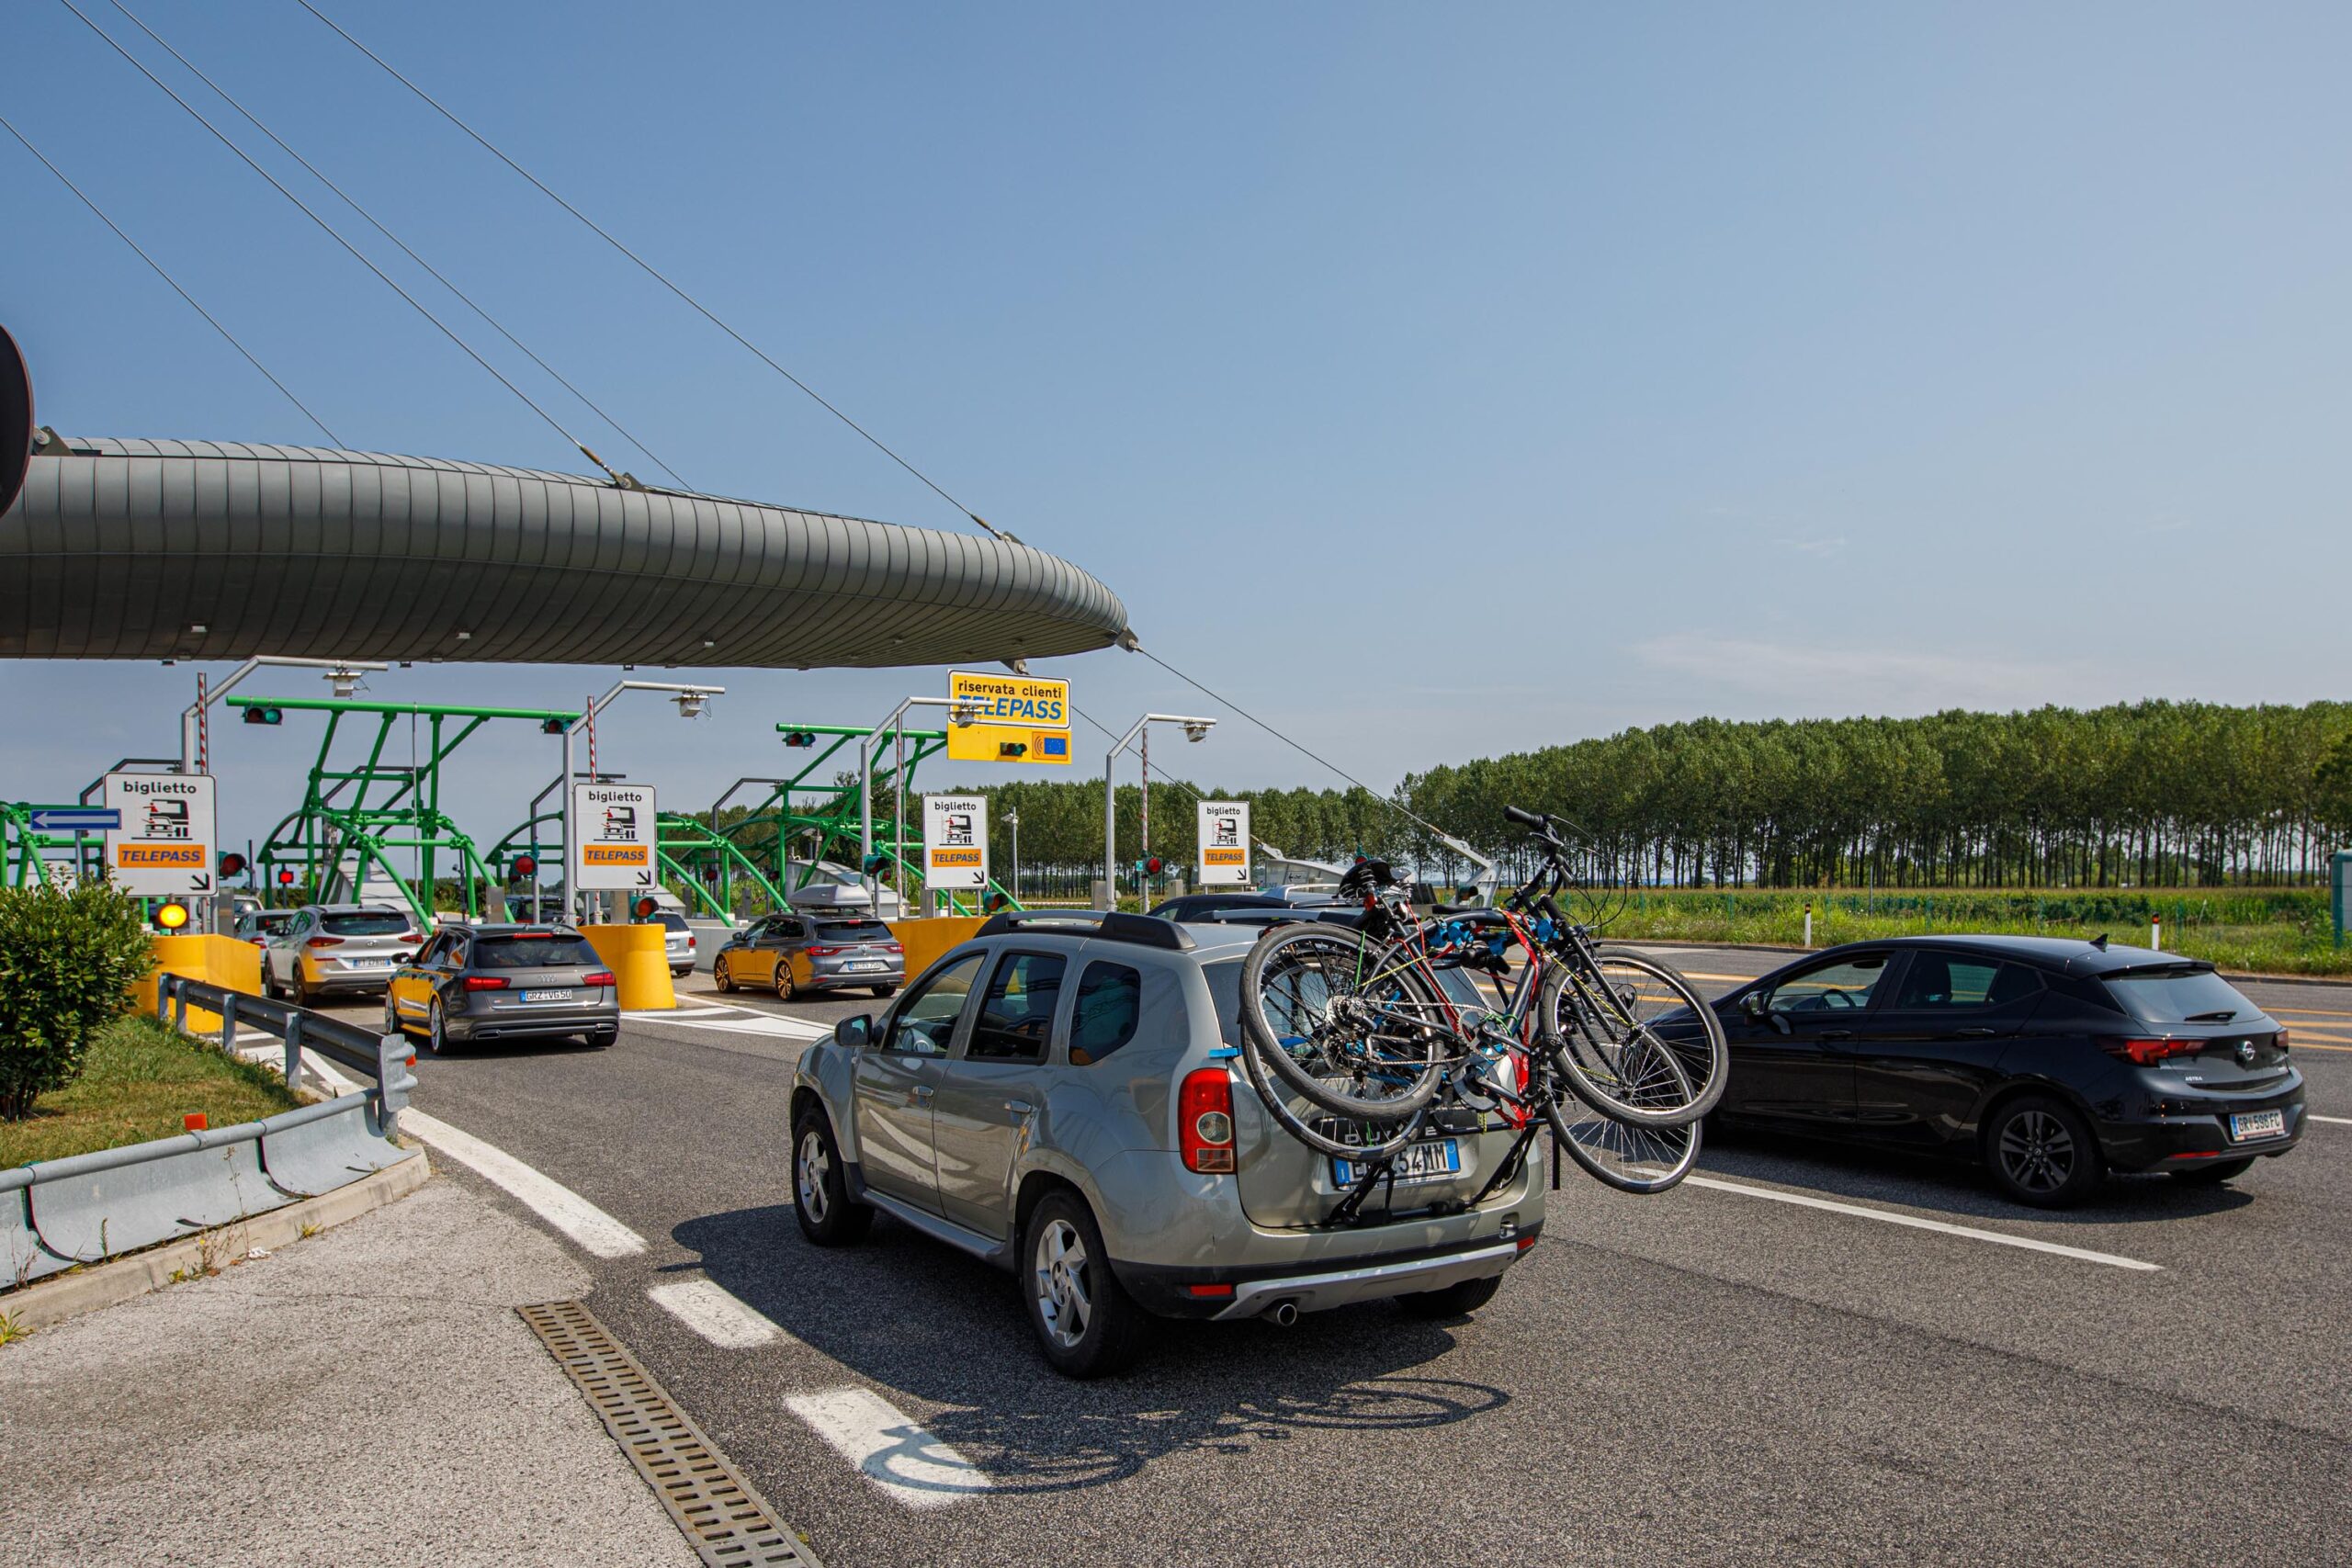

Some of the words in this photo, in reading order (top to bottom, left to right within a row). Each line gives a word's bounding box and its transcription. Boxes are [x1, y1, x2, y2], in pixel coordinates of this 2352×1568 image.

[958, 680, 1015, 695] riservata
[1022, 685, 1062, 704] clienti
[123, 781, 197, 795] biglietto
[588, 791, 642, 803] biglietto
[934, 801, 977, 812] biglietto
[1206, 807, 1241, 817] biglietto
[121, 850, 201, 863] TELEPASS
[587, 850, 645, 861] TELEPASS
[933, 852, 979, 863] TELEPASS
[1206, 852, 1243, 862] TELEPASS
[526, 992, 543, 1000] GRZ
[547, 991, 560, 999] VG
[2237, 1116, 2249, 1133] GR
